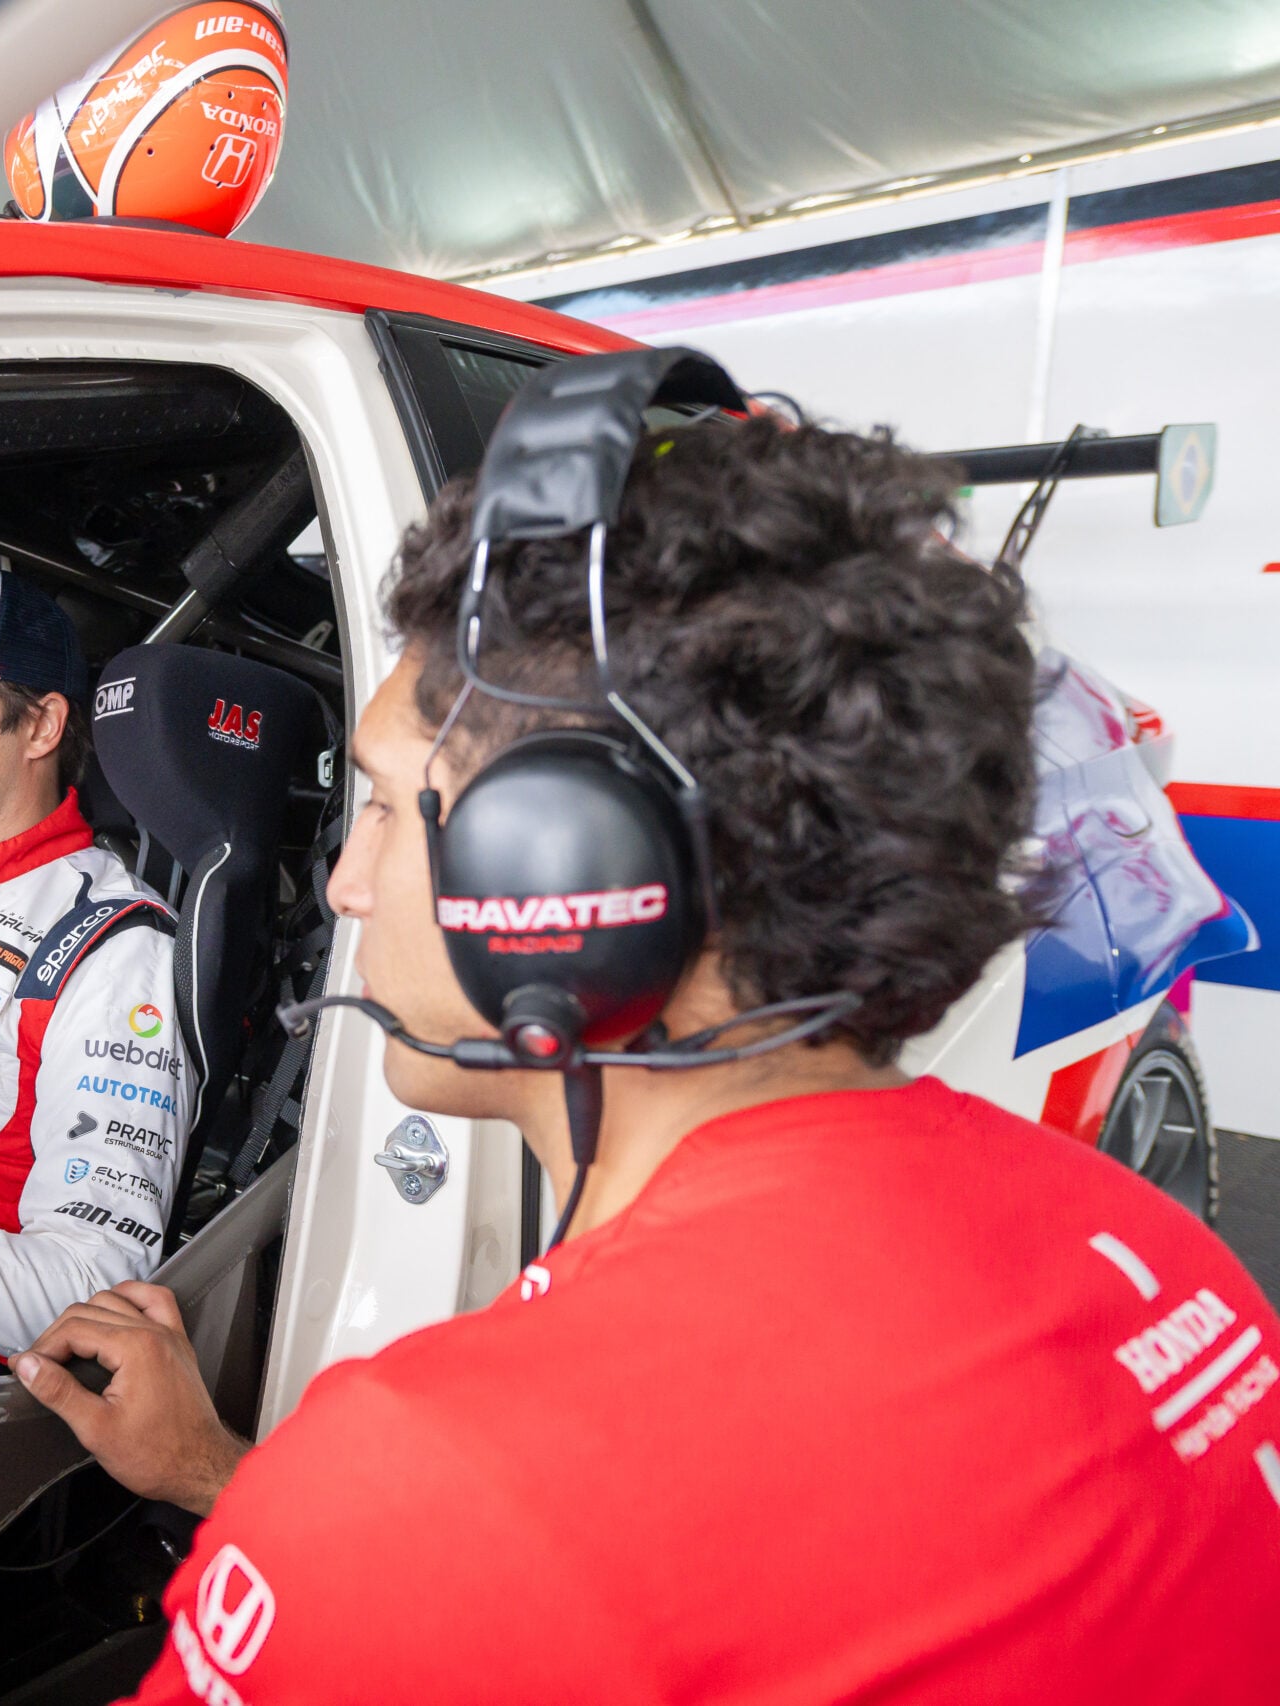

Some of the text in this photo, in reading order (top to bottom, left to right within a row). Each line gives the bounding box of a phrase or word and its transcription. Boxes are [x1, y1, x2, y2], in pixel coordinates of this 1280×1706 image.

[200, 101, 278, 138] HONDA
[95, 683, 134, 714] OMP
[437, 882, 668, 933] BRAVATEC
[36, 906, 118, 986] sparco
[85, 1039, 183, 1080] webdiet
[95, 1166, 163, 1199] ELYTRON
[1114, 1287, 1238, 1394] HONDA
